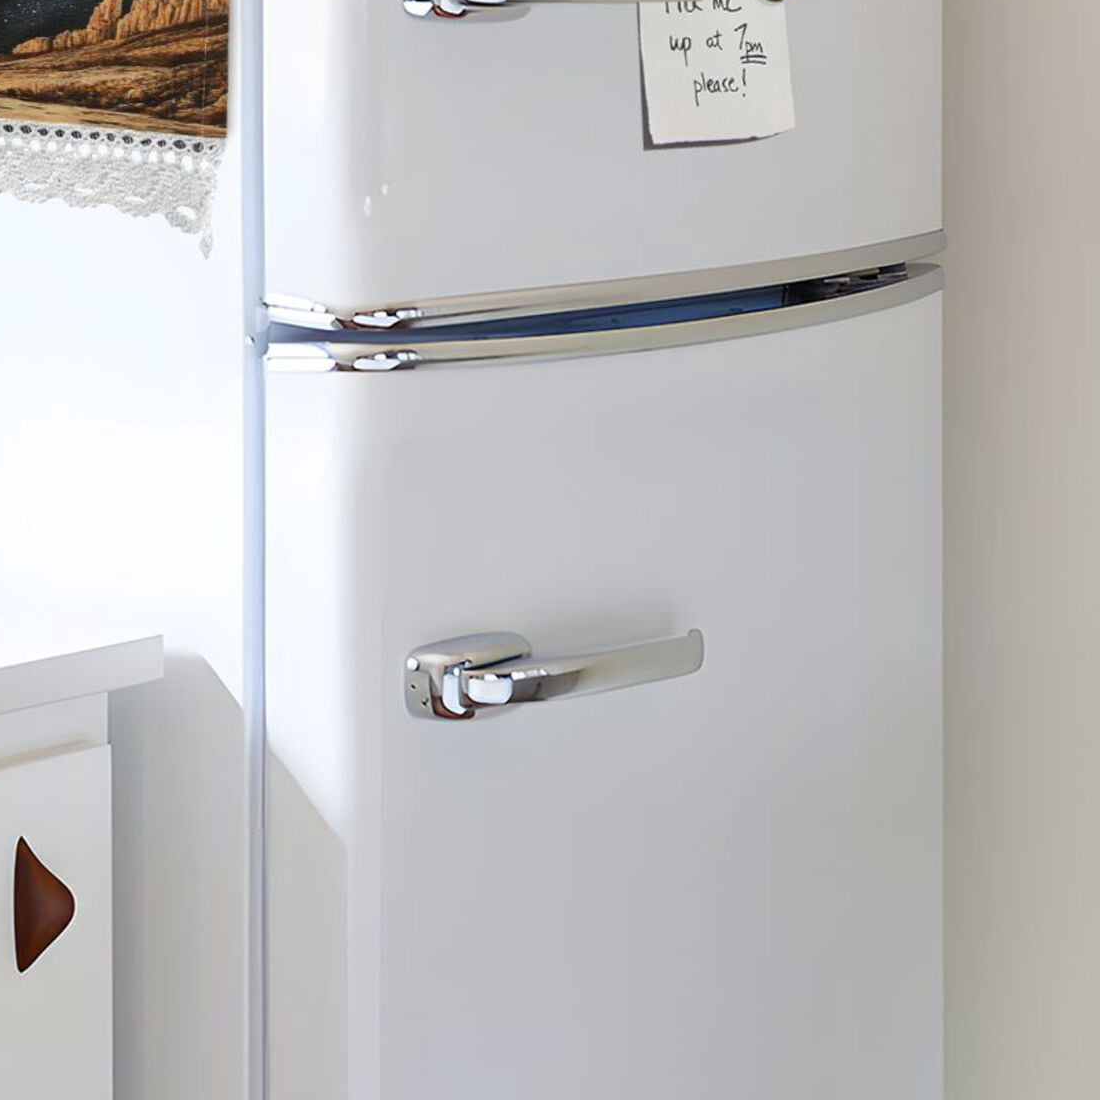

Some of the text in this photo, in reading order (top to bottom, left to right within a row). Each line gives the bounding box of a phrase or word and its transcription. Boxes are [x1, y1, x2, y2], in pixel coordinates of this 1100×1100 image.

[669, 35, 692, 67] up
[706, 30, 723, 50] at
[693, 68, 747, 107] please!
